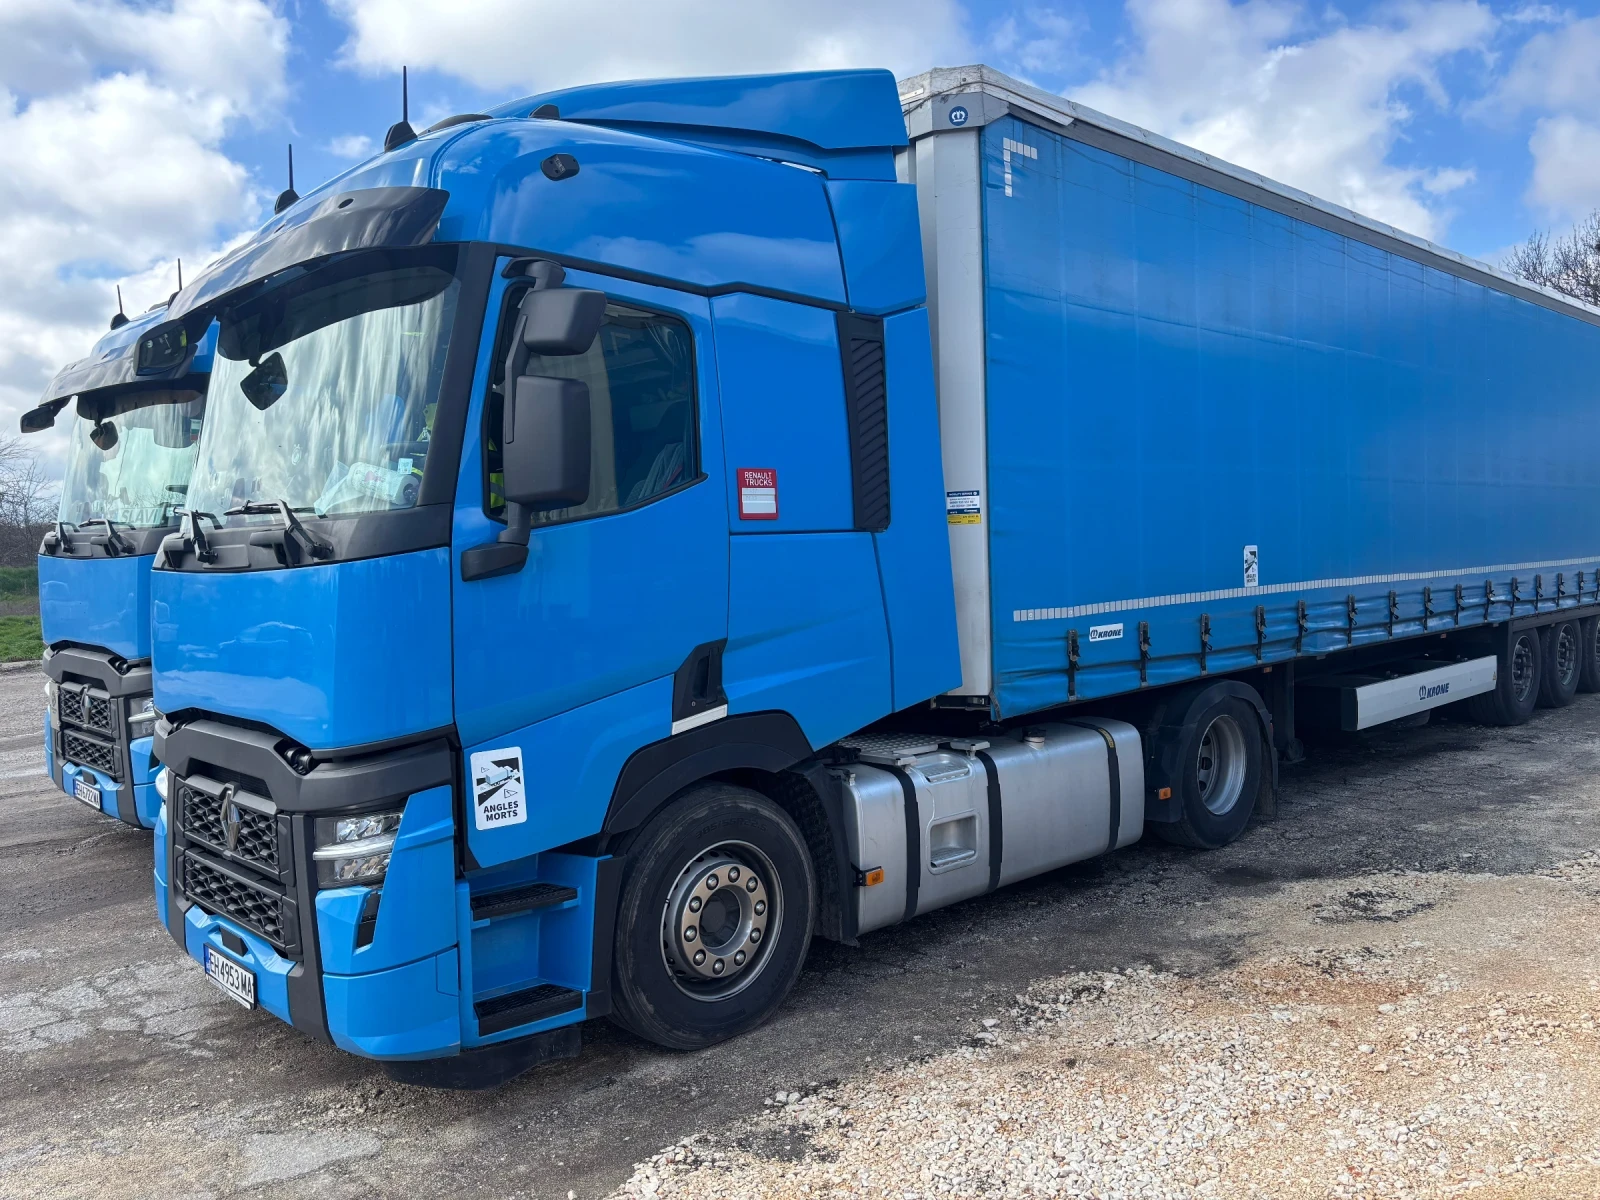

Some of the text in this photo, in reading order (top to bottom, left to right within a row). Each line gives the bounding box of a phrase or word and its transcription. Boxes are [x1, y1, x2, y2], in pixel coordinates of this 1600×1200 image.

[744, 471, 772, 479] RENAULT
[121, 508, 158, 524] SLAVI
[1097, 629, 1122, 639] KRONE
[1427, 682, 1449, 698] KRONE
[483, 801, 519, 814] ANGLES
[485, 809, 518, 822] MORTS
[220, 960, 240, 991] 4953
